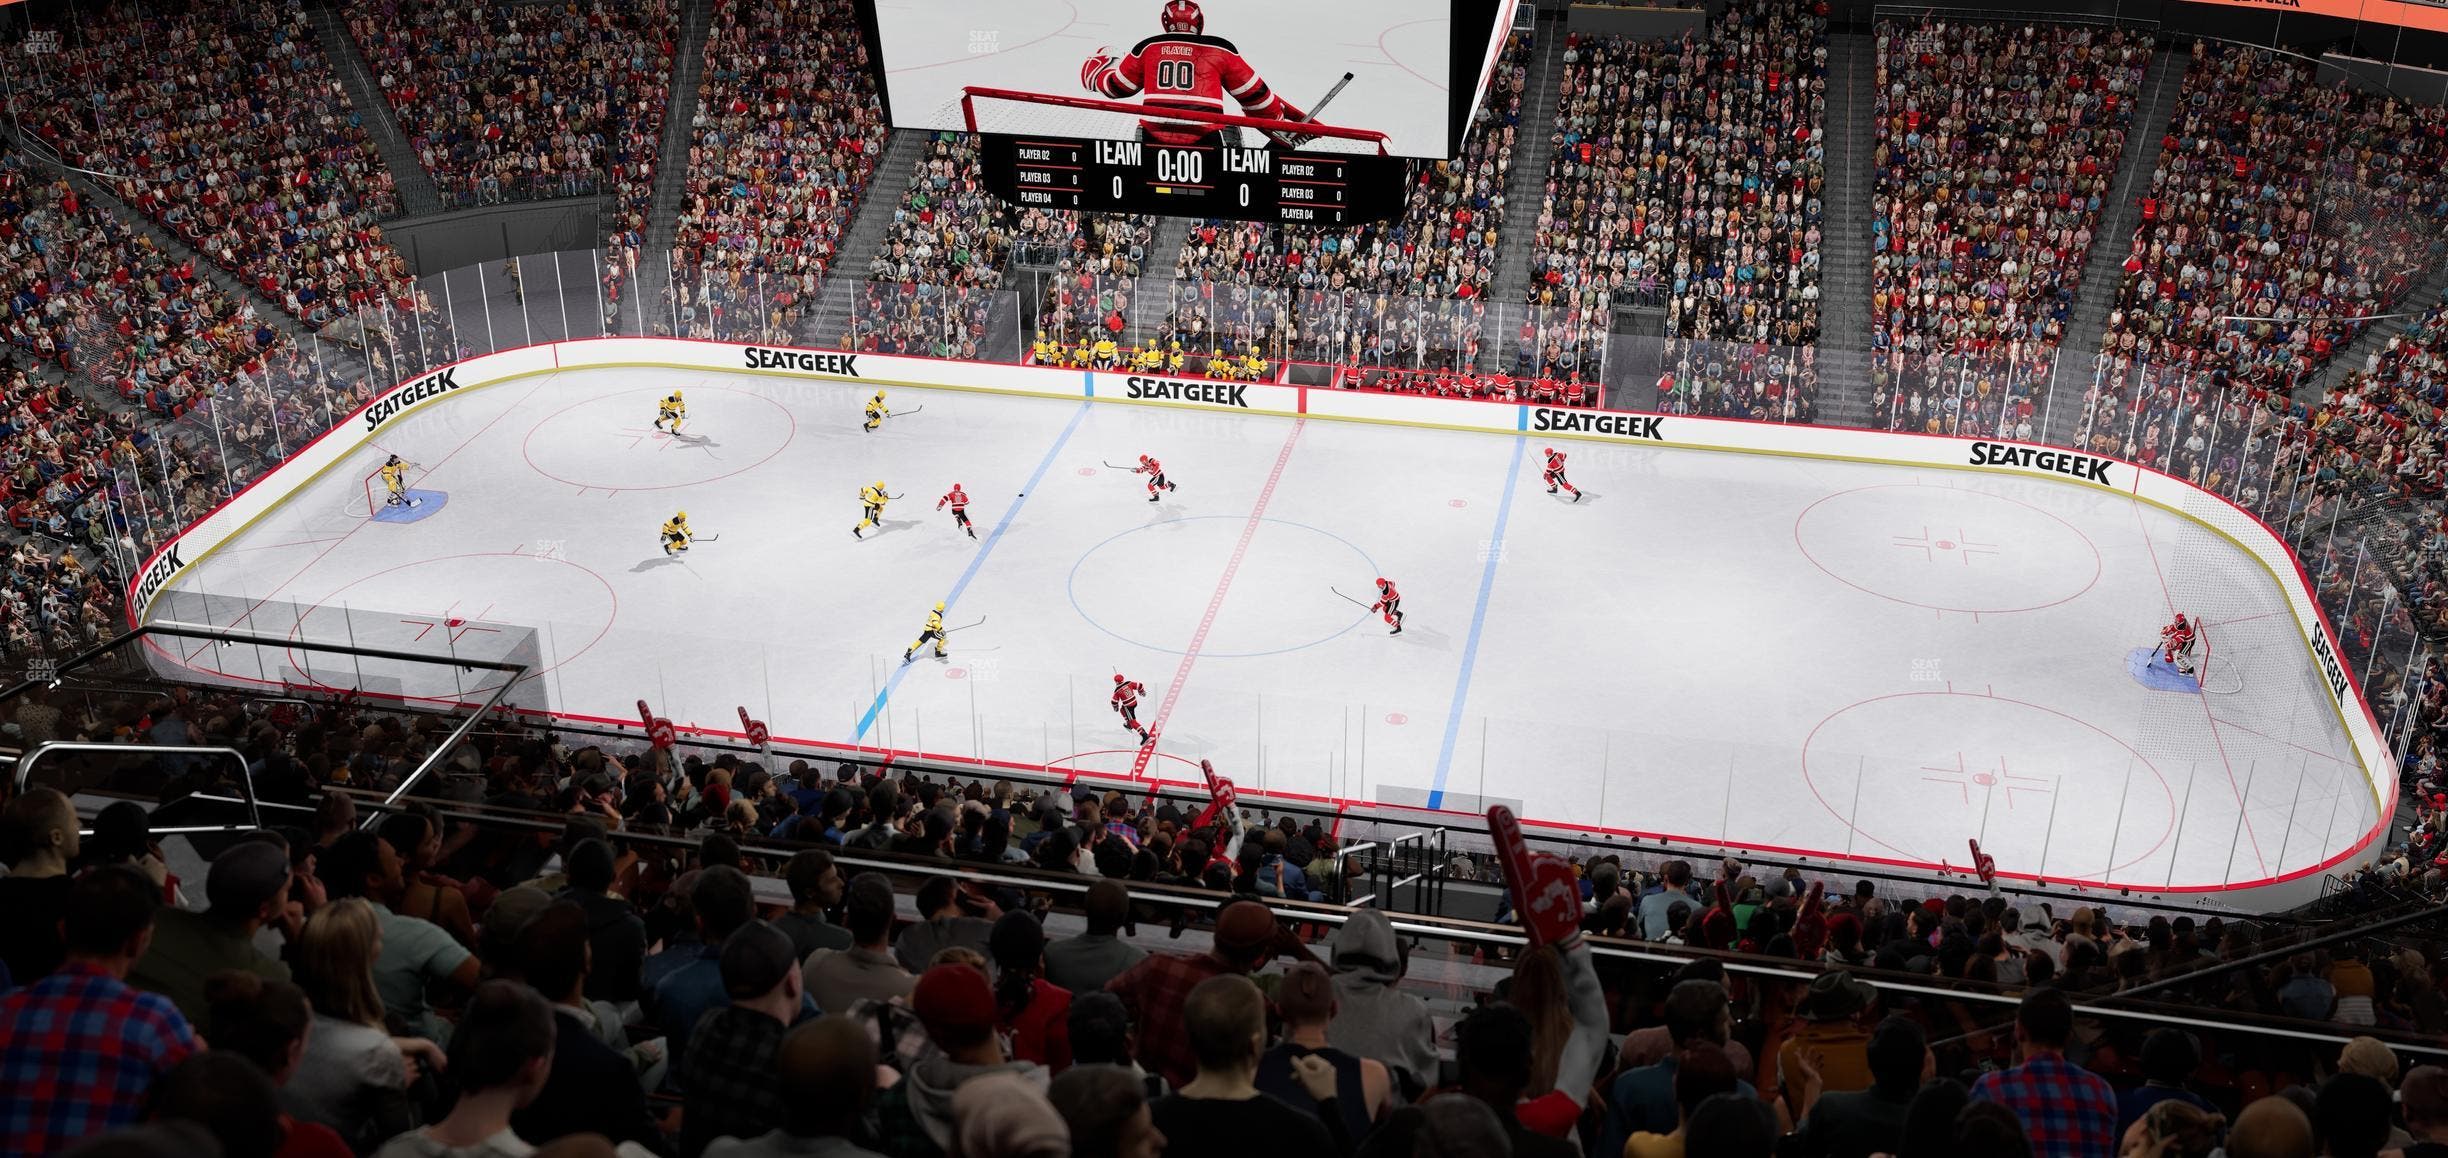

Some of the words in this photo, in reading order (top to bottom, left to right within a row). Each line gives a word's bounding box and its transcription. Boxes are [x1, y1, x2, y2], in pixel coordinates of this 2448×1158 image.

[1162, 46, 1193, 56] PLAYER
[1157, 60, 1194, 90] 00
[1020, 149, 1041, 160] PLAYER
[1042, 150, 1050, 160] 02
[1072, 152, 1076, 162] 0
[1158, 149, 1202, 183] 0:00
[1020, 172, 1042, 183] PLAYER
[1043, 173, 1050, 183] 03
[1073, 175, 1077, 185] 0
[1282, 164, 1304, 176] PLAYER
[1305, 166, 1314, 176] 02
[1337, 168, 1342, 178] 0
[1021, 192, 1042, 203] PLAYER
[1043, 193, 1051, 203] 04
[1073, 195, 1078, 205] 0
[1112, 176, 1122, 199] 0
[1240, 183, 1249, 207] 0
[1282, 188, 1304, 199] PLAYER
[1305, 189, 1313, 199] 03
[1337, 191, 1341, 201] 0
[1282, 208, 1304, 219] PLAYER
[1305, 210, 1313, 220] 04
[1336, 212, 1341, 222] 0
[744, 347, 860, 377] SEATGEEK
[366, 367, 460, 432] SEATGEEK
[1127, 376, 1248, 408] SEATGEEK
[1534, 408, 1664, 440] SEATGEEK
[1970, 442, 2114, 486] SEATGEEK
[2312, 621, 2348, 709] SEATGEEK
